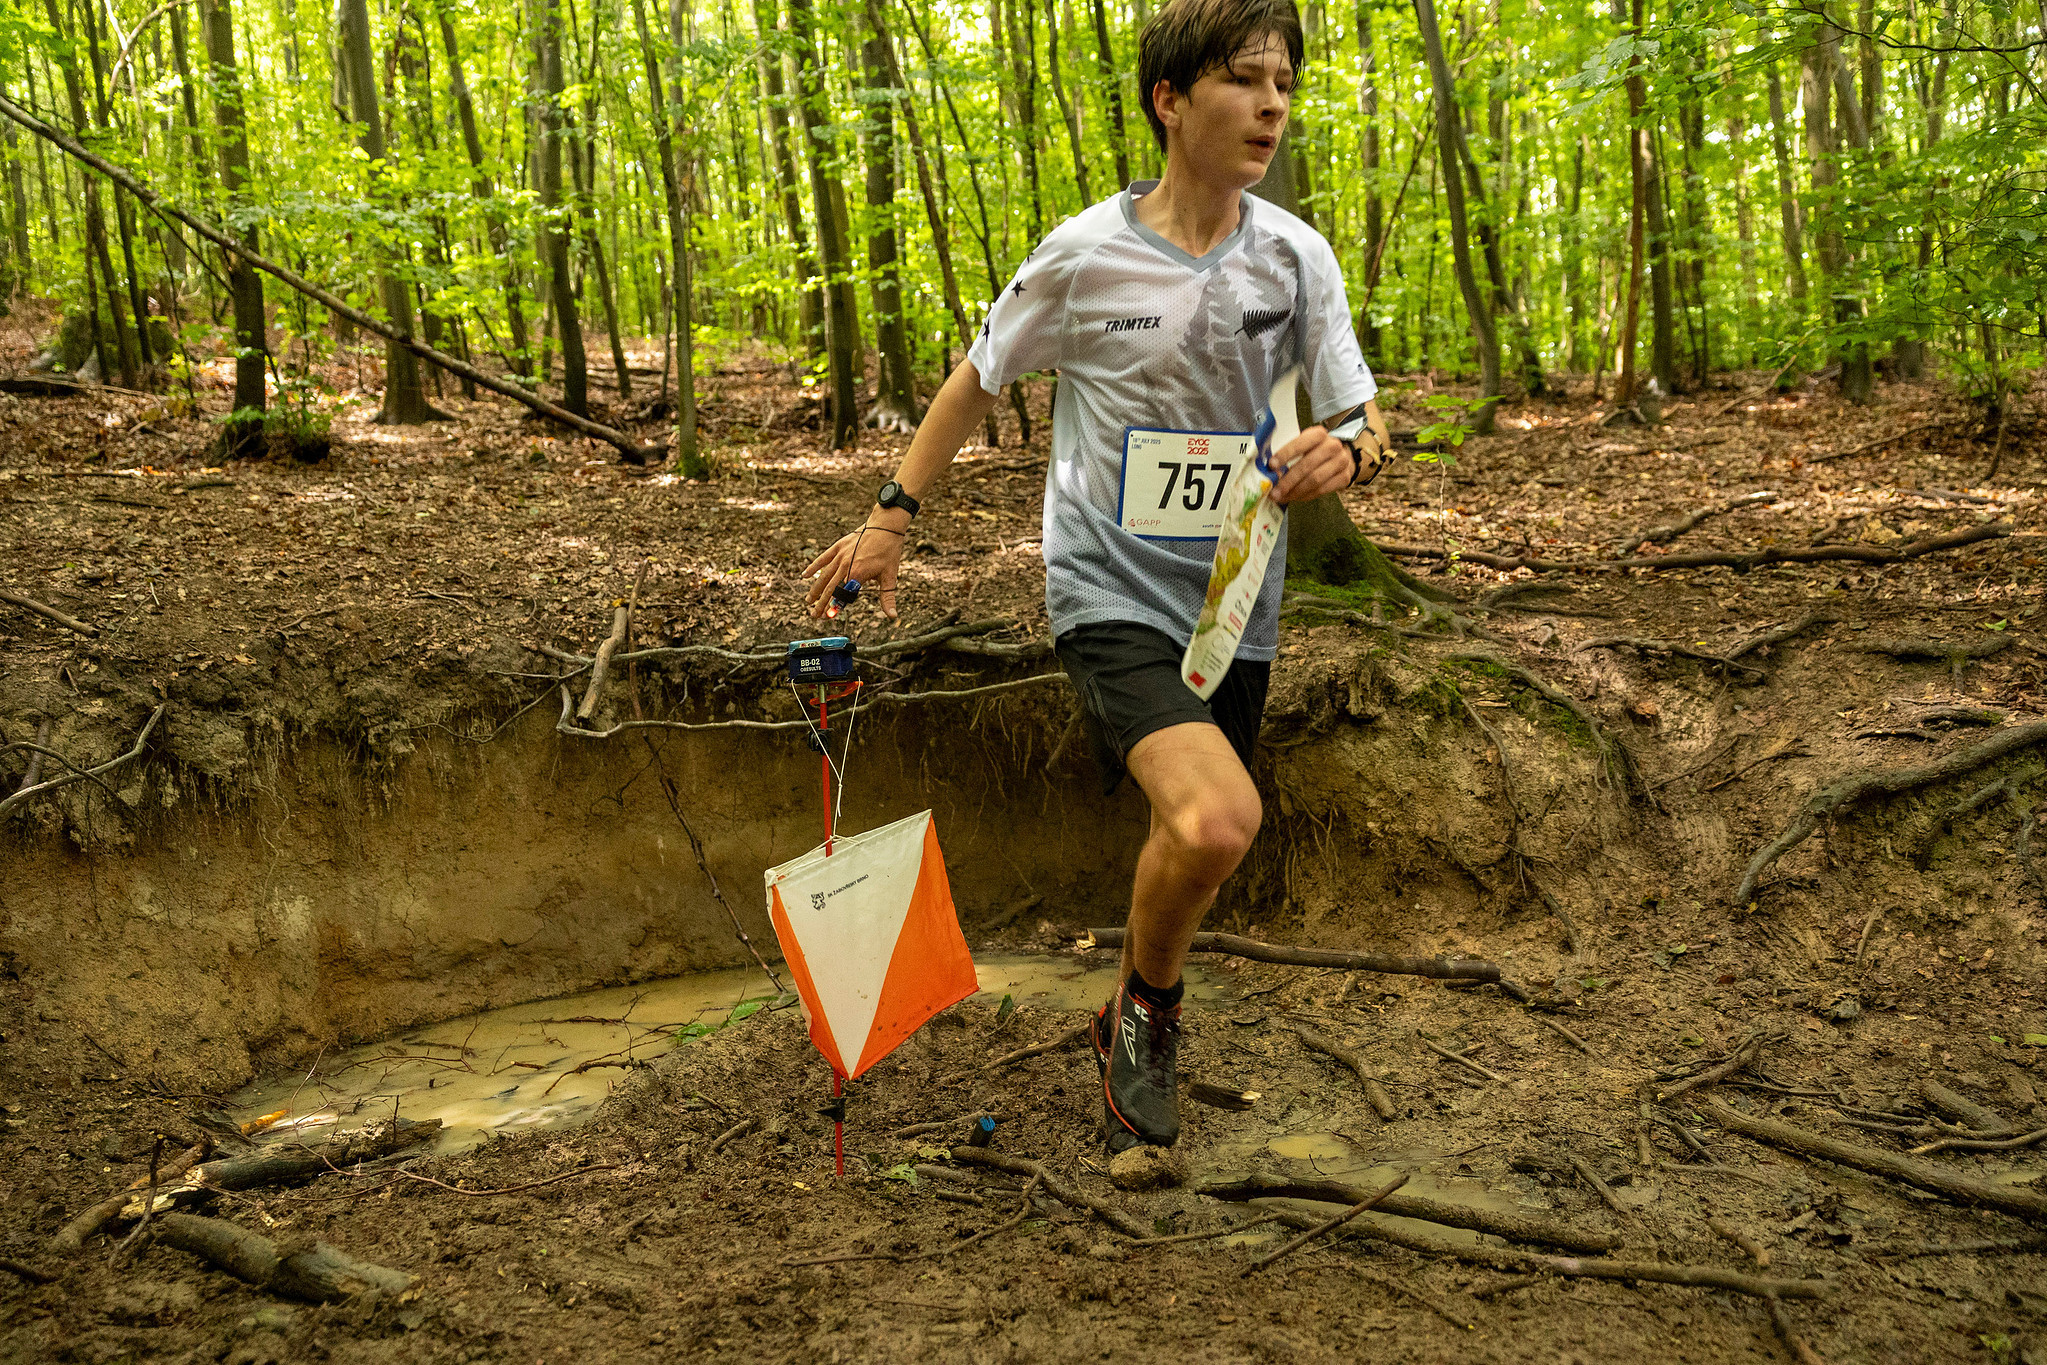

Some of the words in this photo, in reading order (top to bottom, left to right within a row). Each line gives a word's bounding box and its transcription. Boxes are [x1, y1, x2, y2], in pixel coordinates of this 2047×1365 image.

[1104, 316, 1162, 333] TRIMTEX
[1187, 438, 1210, 446] EYOC
[1187, 447, 1209, 455] 2025
[1158, 462, 1232, 511] 757
[1136, 519, 1161, 527] GAPP
[800, 658, 820, 667] BB-02
